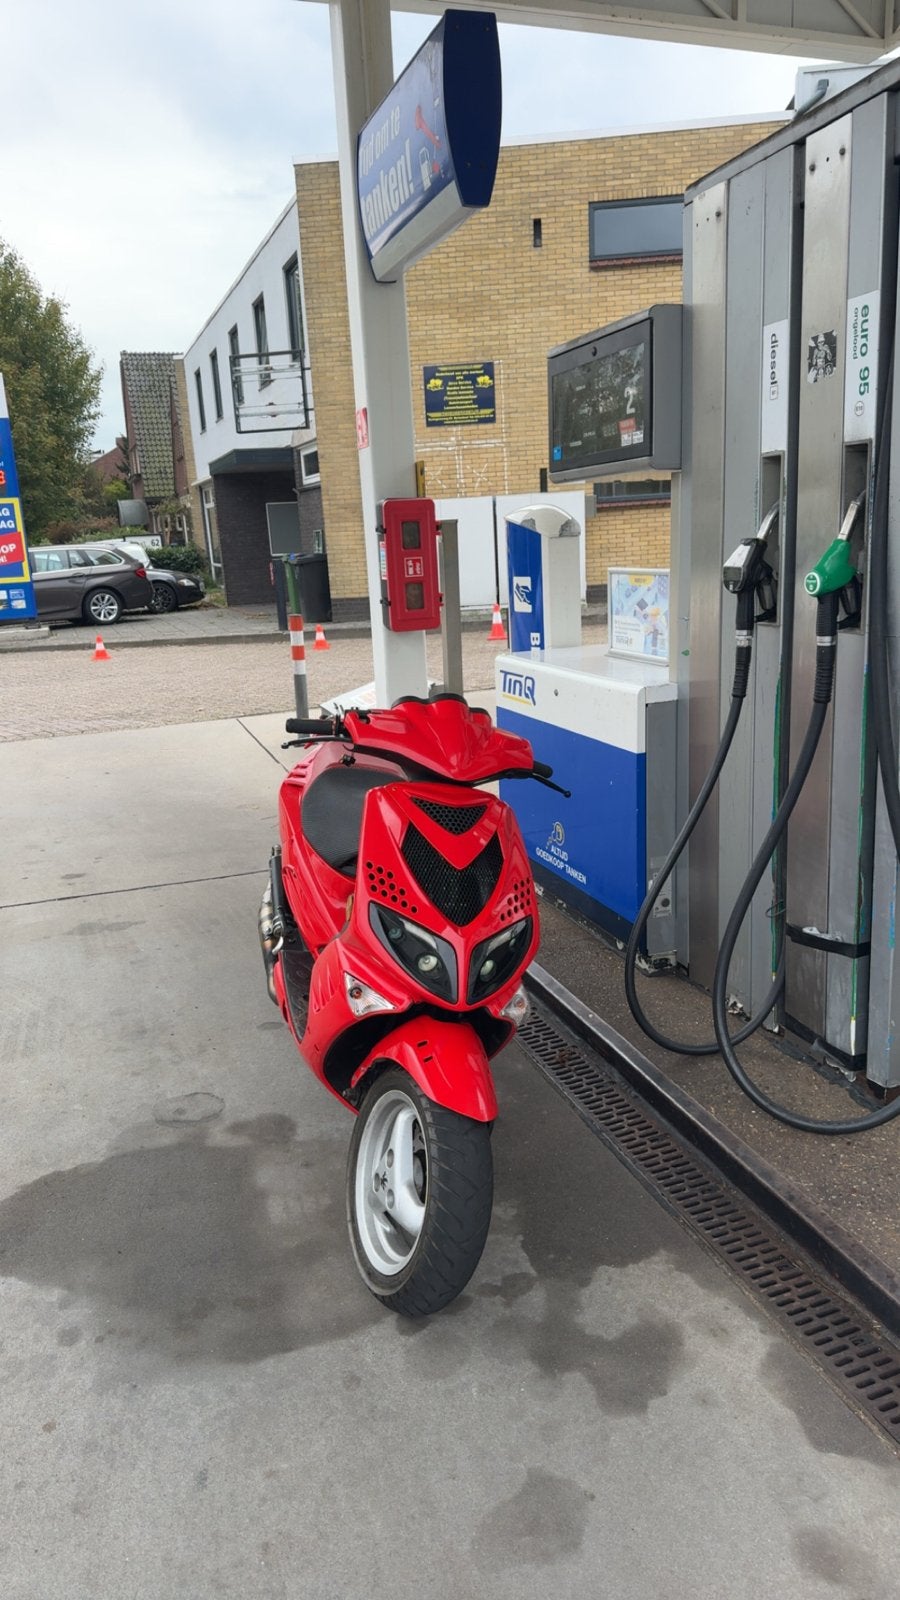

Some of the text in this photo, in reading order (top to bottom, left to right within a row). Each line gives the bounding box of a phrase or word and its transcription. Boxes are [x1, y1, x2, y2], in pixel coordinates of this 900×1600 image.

[375, 119, 389, 159] om
[390, 105, 400, 139] te
[770, 333, 779, 385] diesel
[858, 304, 870, 396] euro 95
[624, 386, 637, 415] 2
[151, 539, 160, 547] 62
[535, 847, 587, 885] GOEDKOOP TANKEN
[551, 844, 569, 861] ALTIJD
